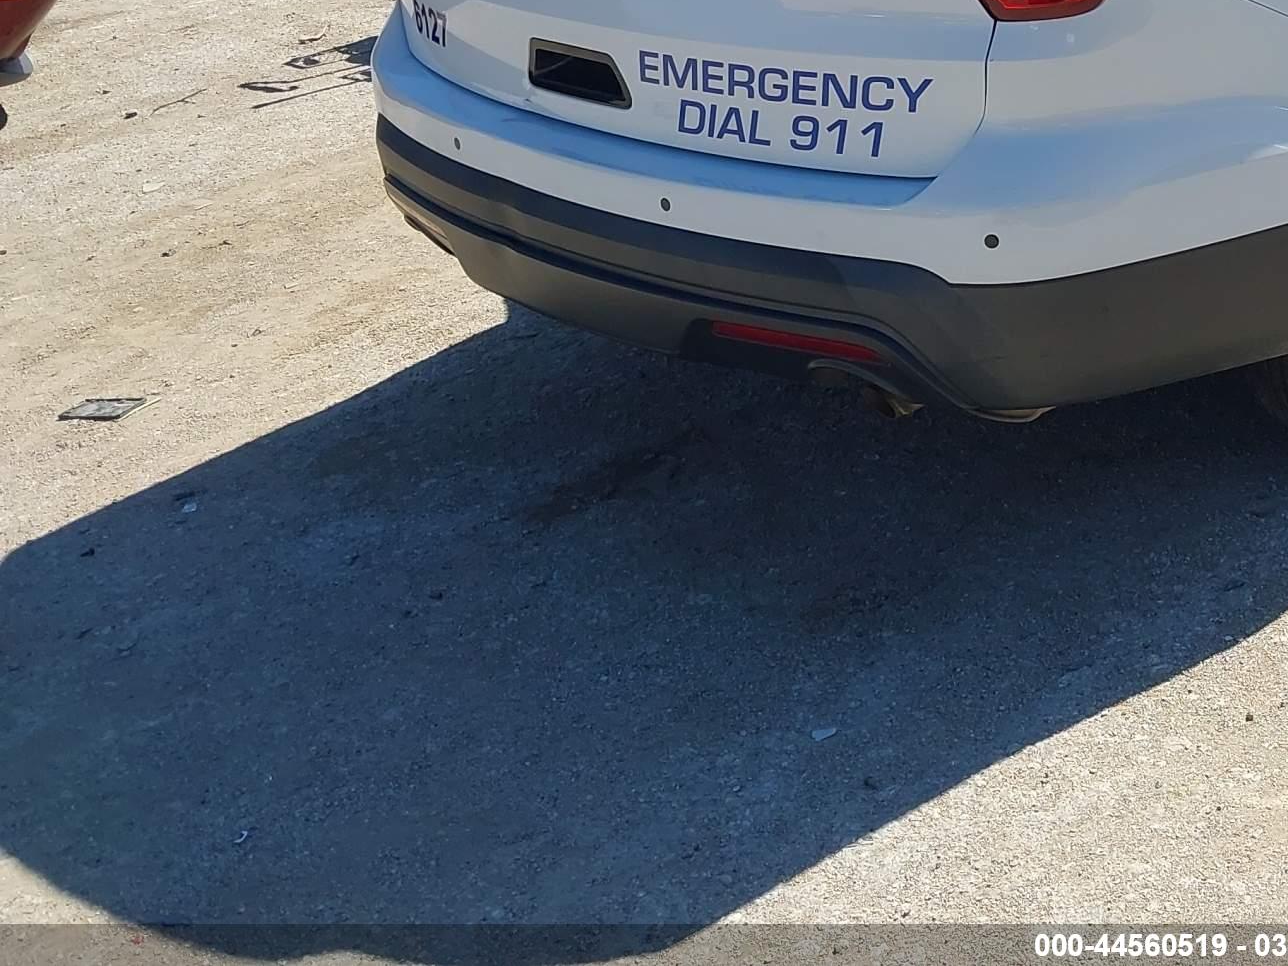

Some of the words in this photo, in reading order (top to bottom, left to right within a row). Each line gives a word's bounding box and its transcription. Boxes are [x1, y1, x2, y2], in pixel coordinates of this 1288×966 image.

[638, 49, 935, 114] EMERGENCY
[677, 98, 772, 147] DIAL
[789, 115, 884, 158] 911
